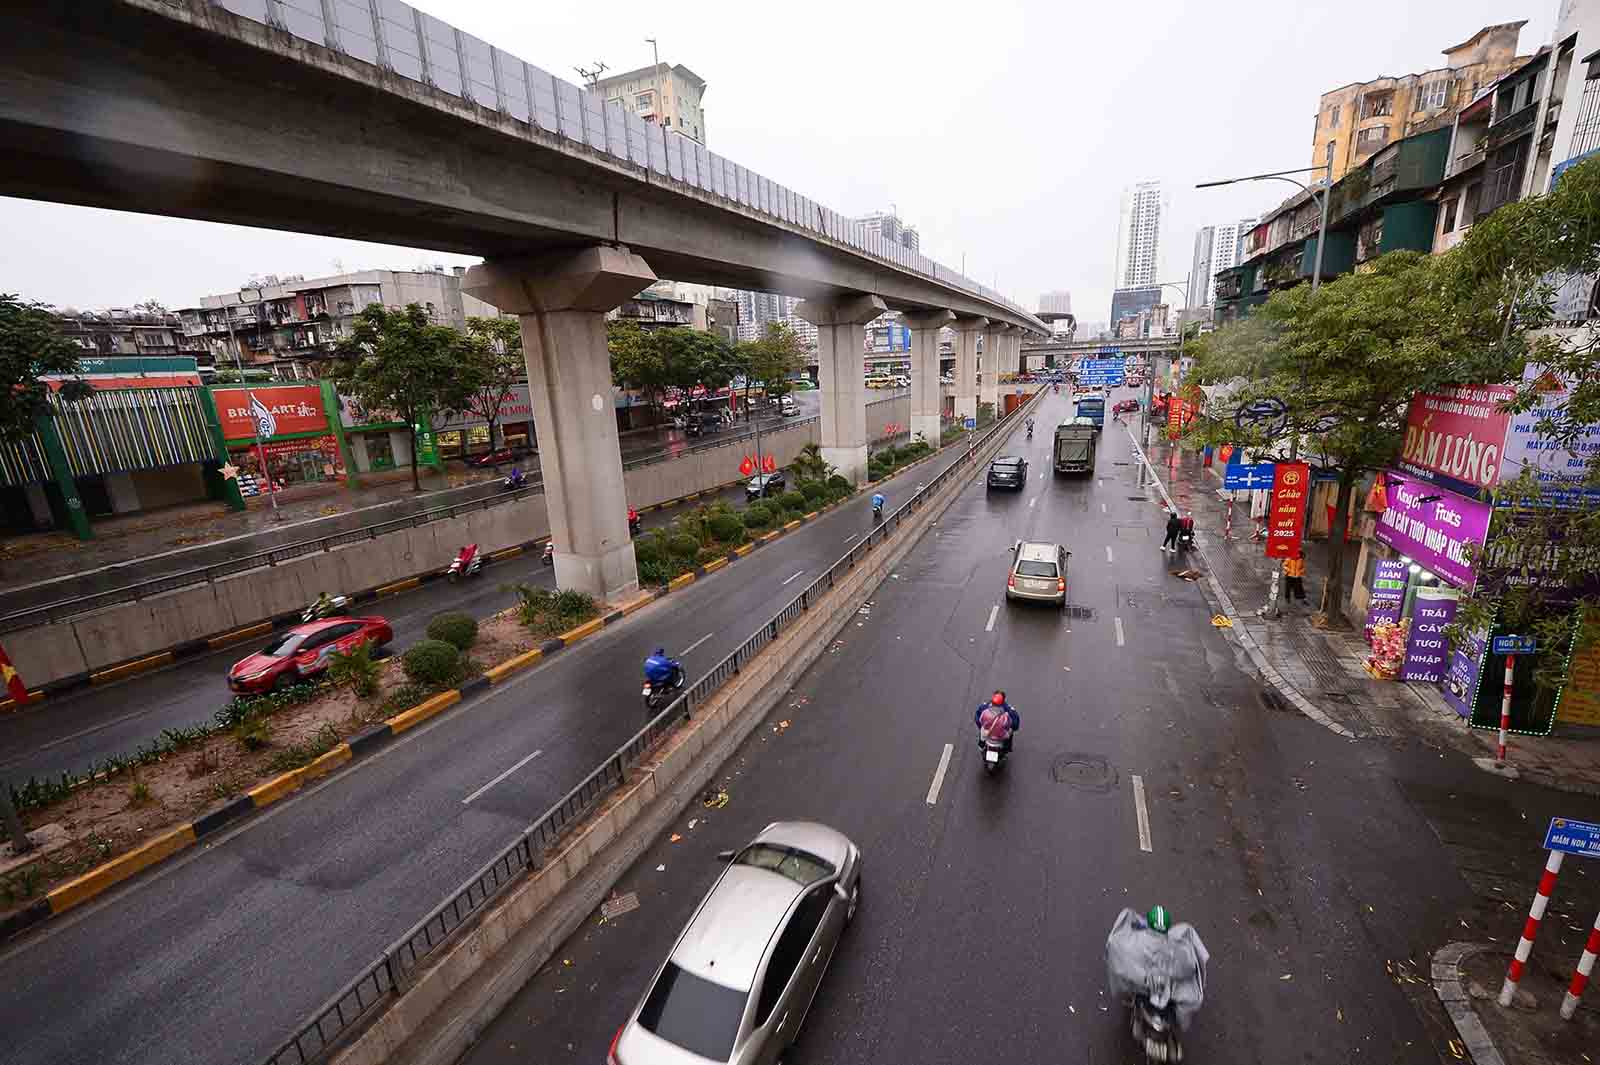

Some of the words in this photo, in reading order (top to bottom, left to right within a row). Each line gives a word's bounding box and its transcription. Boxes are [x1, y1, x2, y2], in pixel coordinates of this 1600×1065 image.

[1440, 432, 1497, 485] LƯNG
[1421, 604, 1447, 618] TRÁI
[1373, 615, 1393, 624] TÁO
[1415, 639, 1442, 649] TƯƠI
[1410, 654, 1441, 665] NHẬP
[1406, 671, 1438, 682] KHẨU
[1570, 838, 1587, 849] NON
